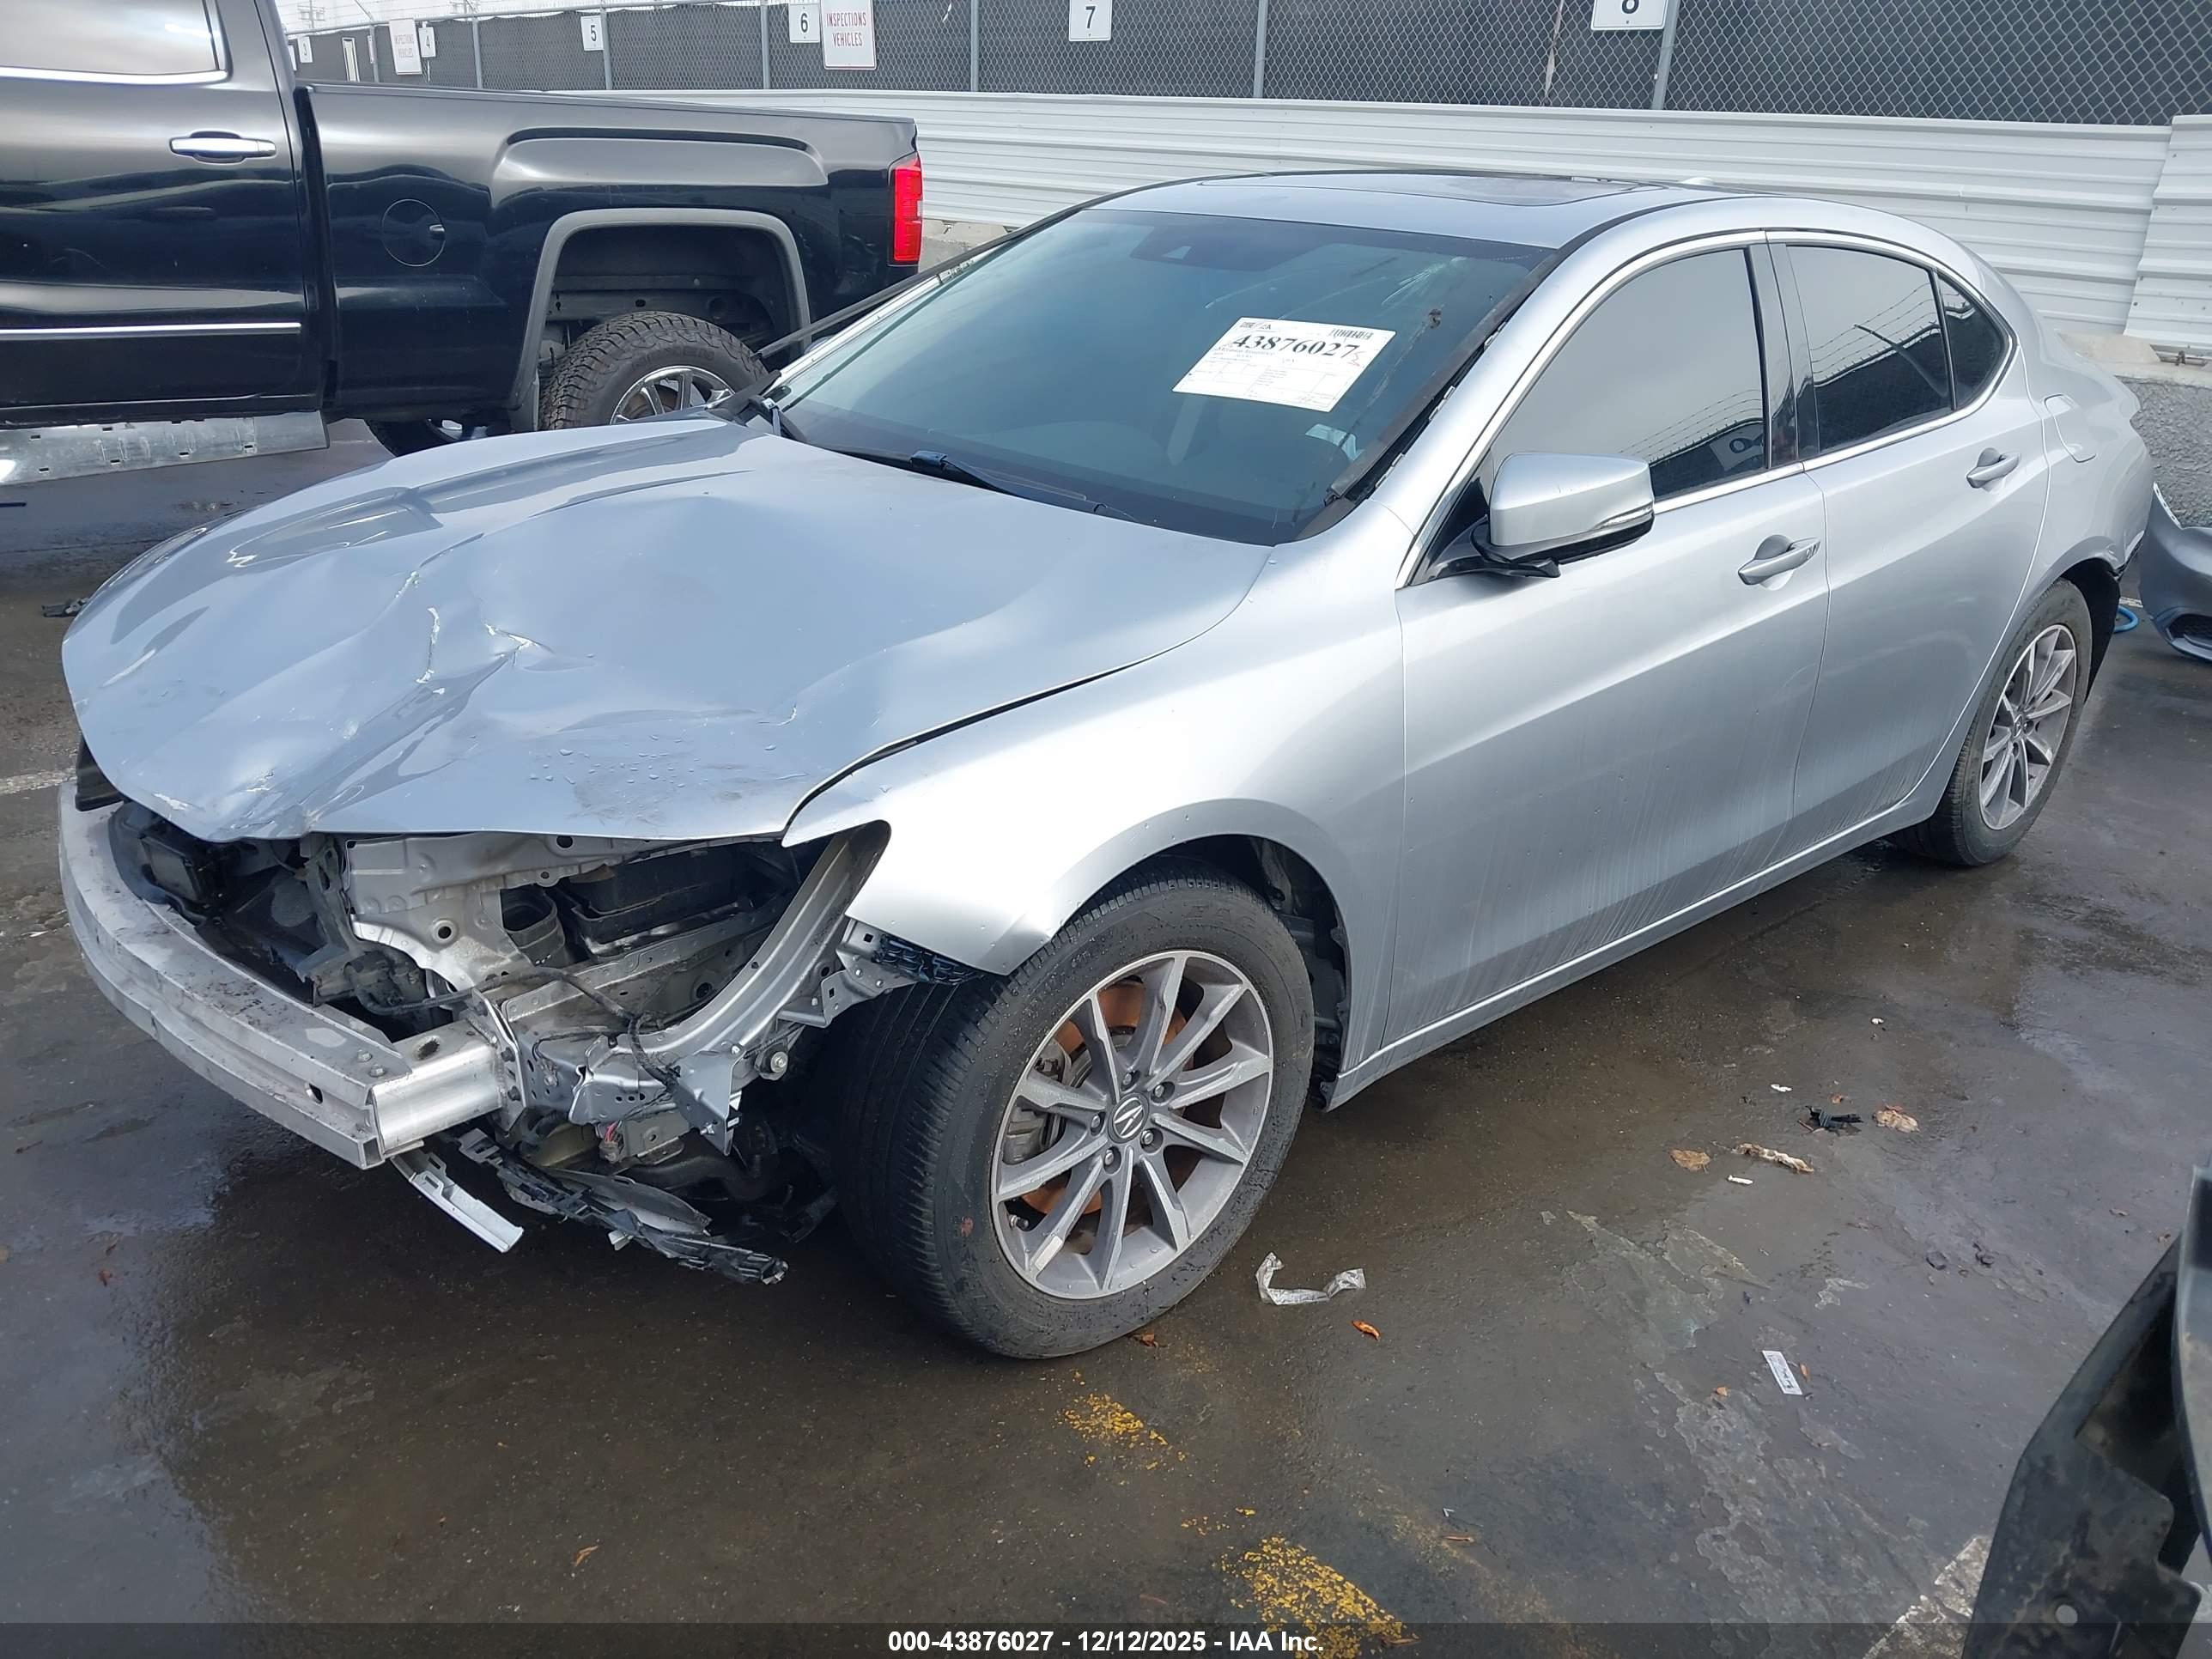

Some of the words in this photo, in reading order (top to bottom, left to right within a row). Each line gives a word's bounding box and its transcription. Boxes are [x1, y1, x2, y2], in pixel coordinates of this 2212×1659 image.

[800, 13, 808, 33] 6
[826, 12, 866, 27] INSPECTIONS
[1085, 6, 1096, 28] 7
[590, 24, 597, 41] 5
[832, 32, 862, 46] VEHICLES
[1233, 335, 1359, 358] 43876027
